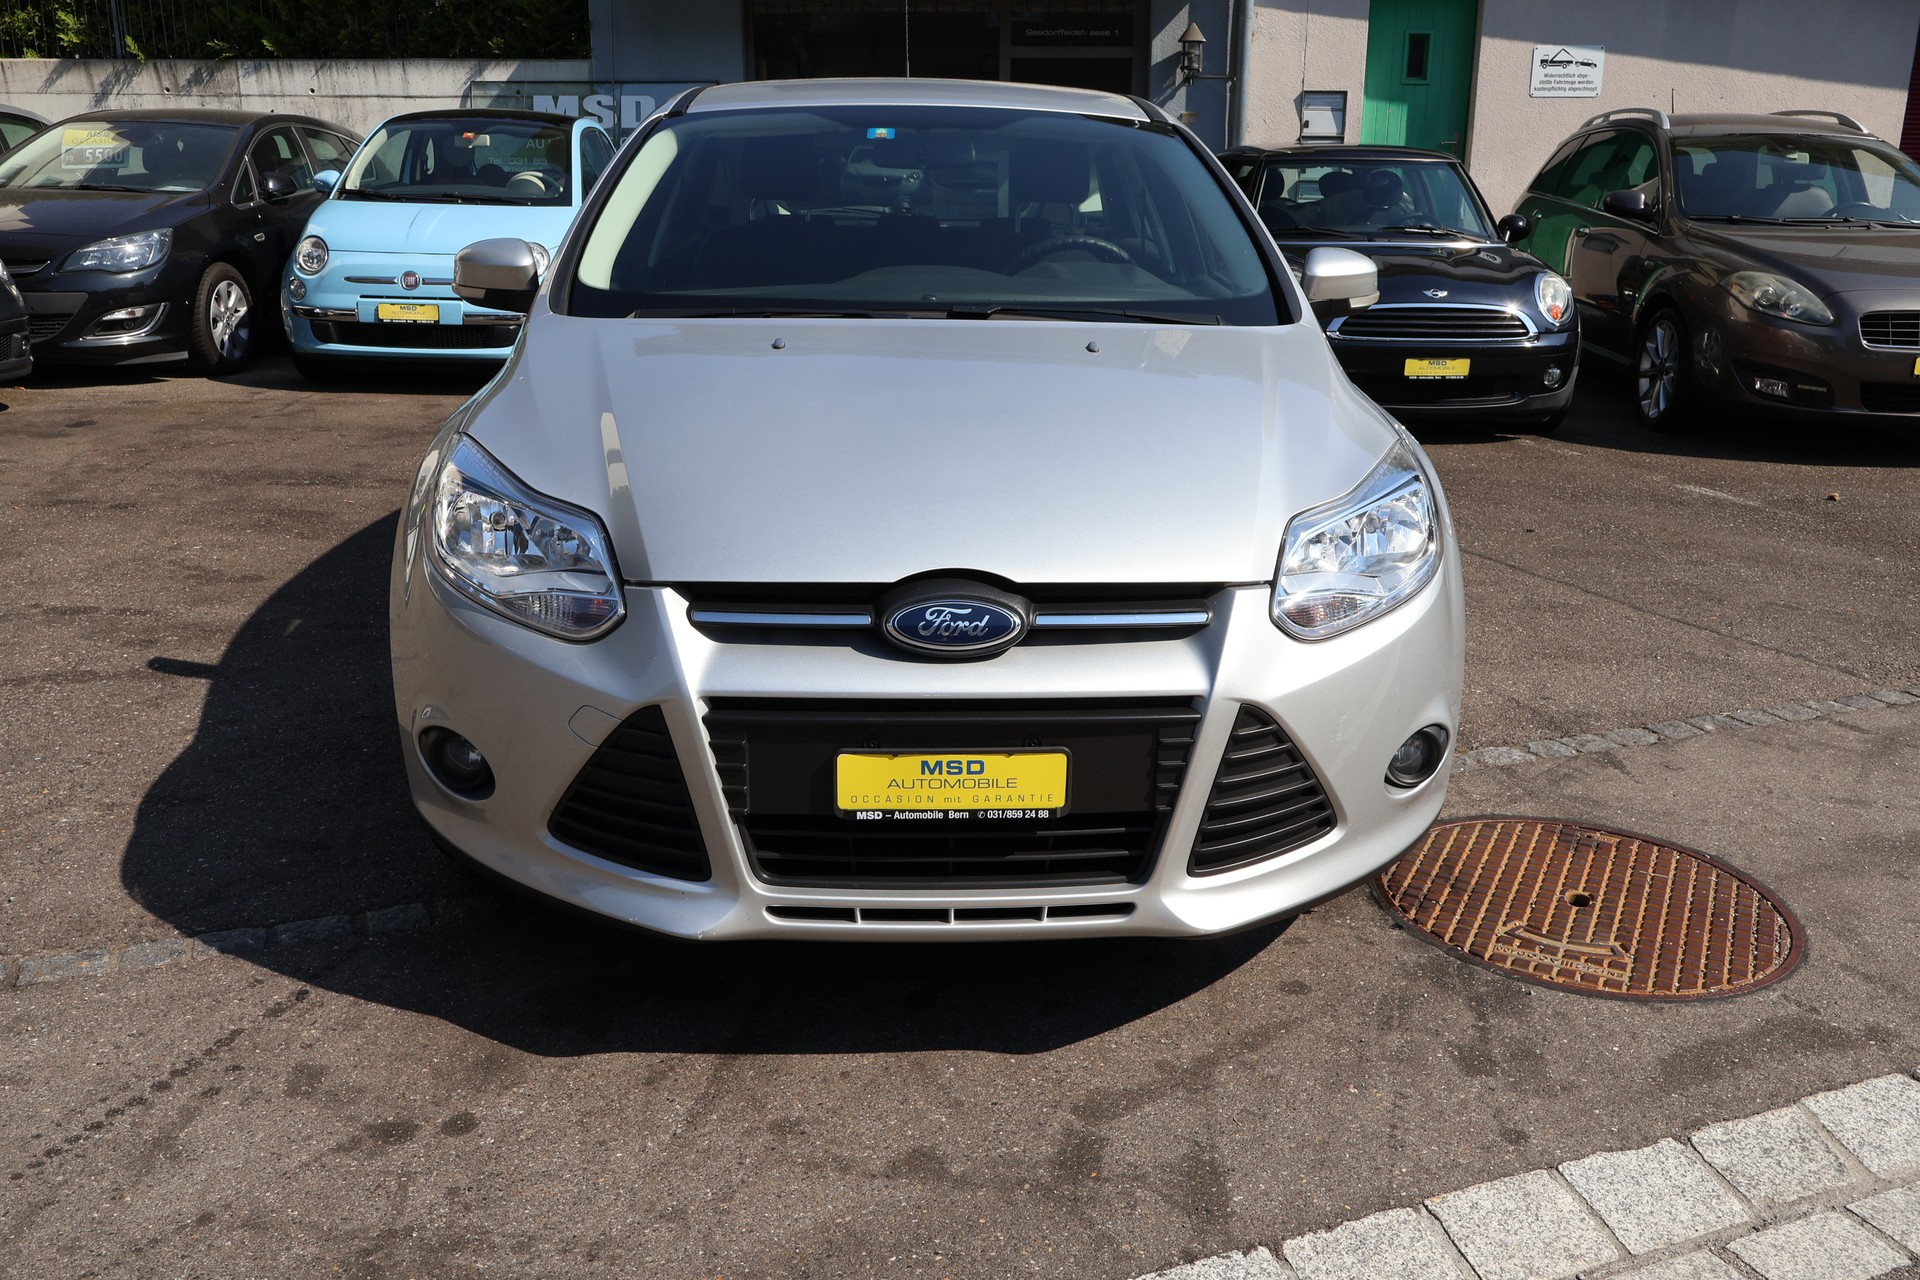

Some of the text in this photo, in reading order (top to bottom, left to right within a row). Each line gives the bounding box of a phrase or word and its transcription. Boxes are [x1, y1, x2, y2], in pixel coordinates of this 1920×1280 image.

[533, 95, 656, 129] MSD
[508, 157, 528, 165] 031
[917, 606, 990, 637] Ford
[920, 760, 985, 775] MSD
[887, 778, 1018, 789] AUTOMOBILE
[850, 794, 1054, 804] OCCASION mit GARANTIE
[856, 811, 883, 820] MSD
[893, 810, 944, 820] Automobile
[948, 811, 969, 819] Bern
[987, 809, 1023, 819] 031/859
[1025, 809, 1036, 819] 24
[1037, 809, 1049, 818] 88
